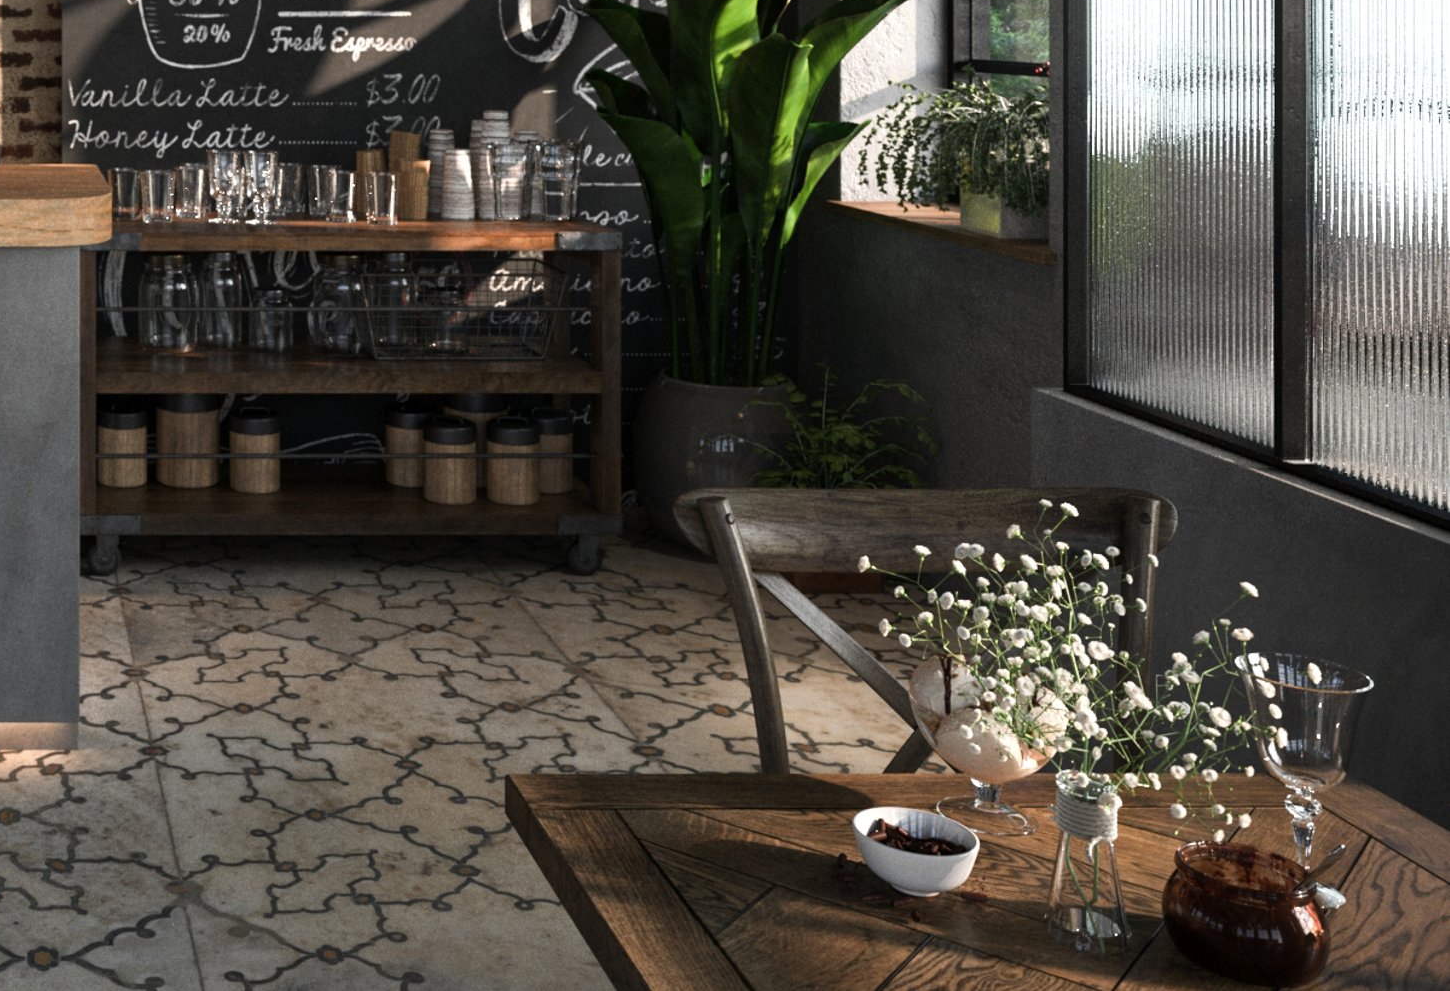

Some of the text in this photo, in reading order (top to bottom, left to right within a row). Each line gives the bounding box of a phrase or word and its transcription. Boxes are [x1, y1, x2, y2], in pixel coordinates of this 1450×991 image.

[182, 23, 231, 44] 20%
[267, 24, 418, 62] Fresh Espresso
[68, 73, 442, 108] Vanilla Latte $3.00
[68, 119, 179, 159] Honey
[181, 119, 277, 150] Latte
